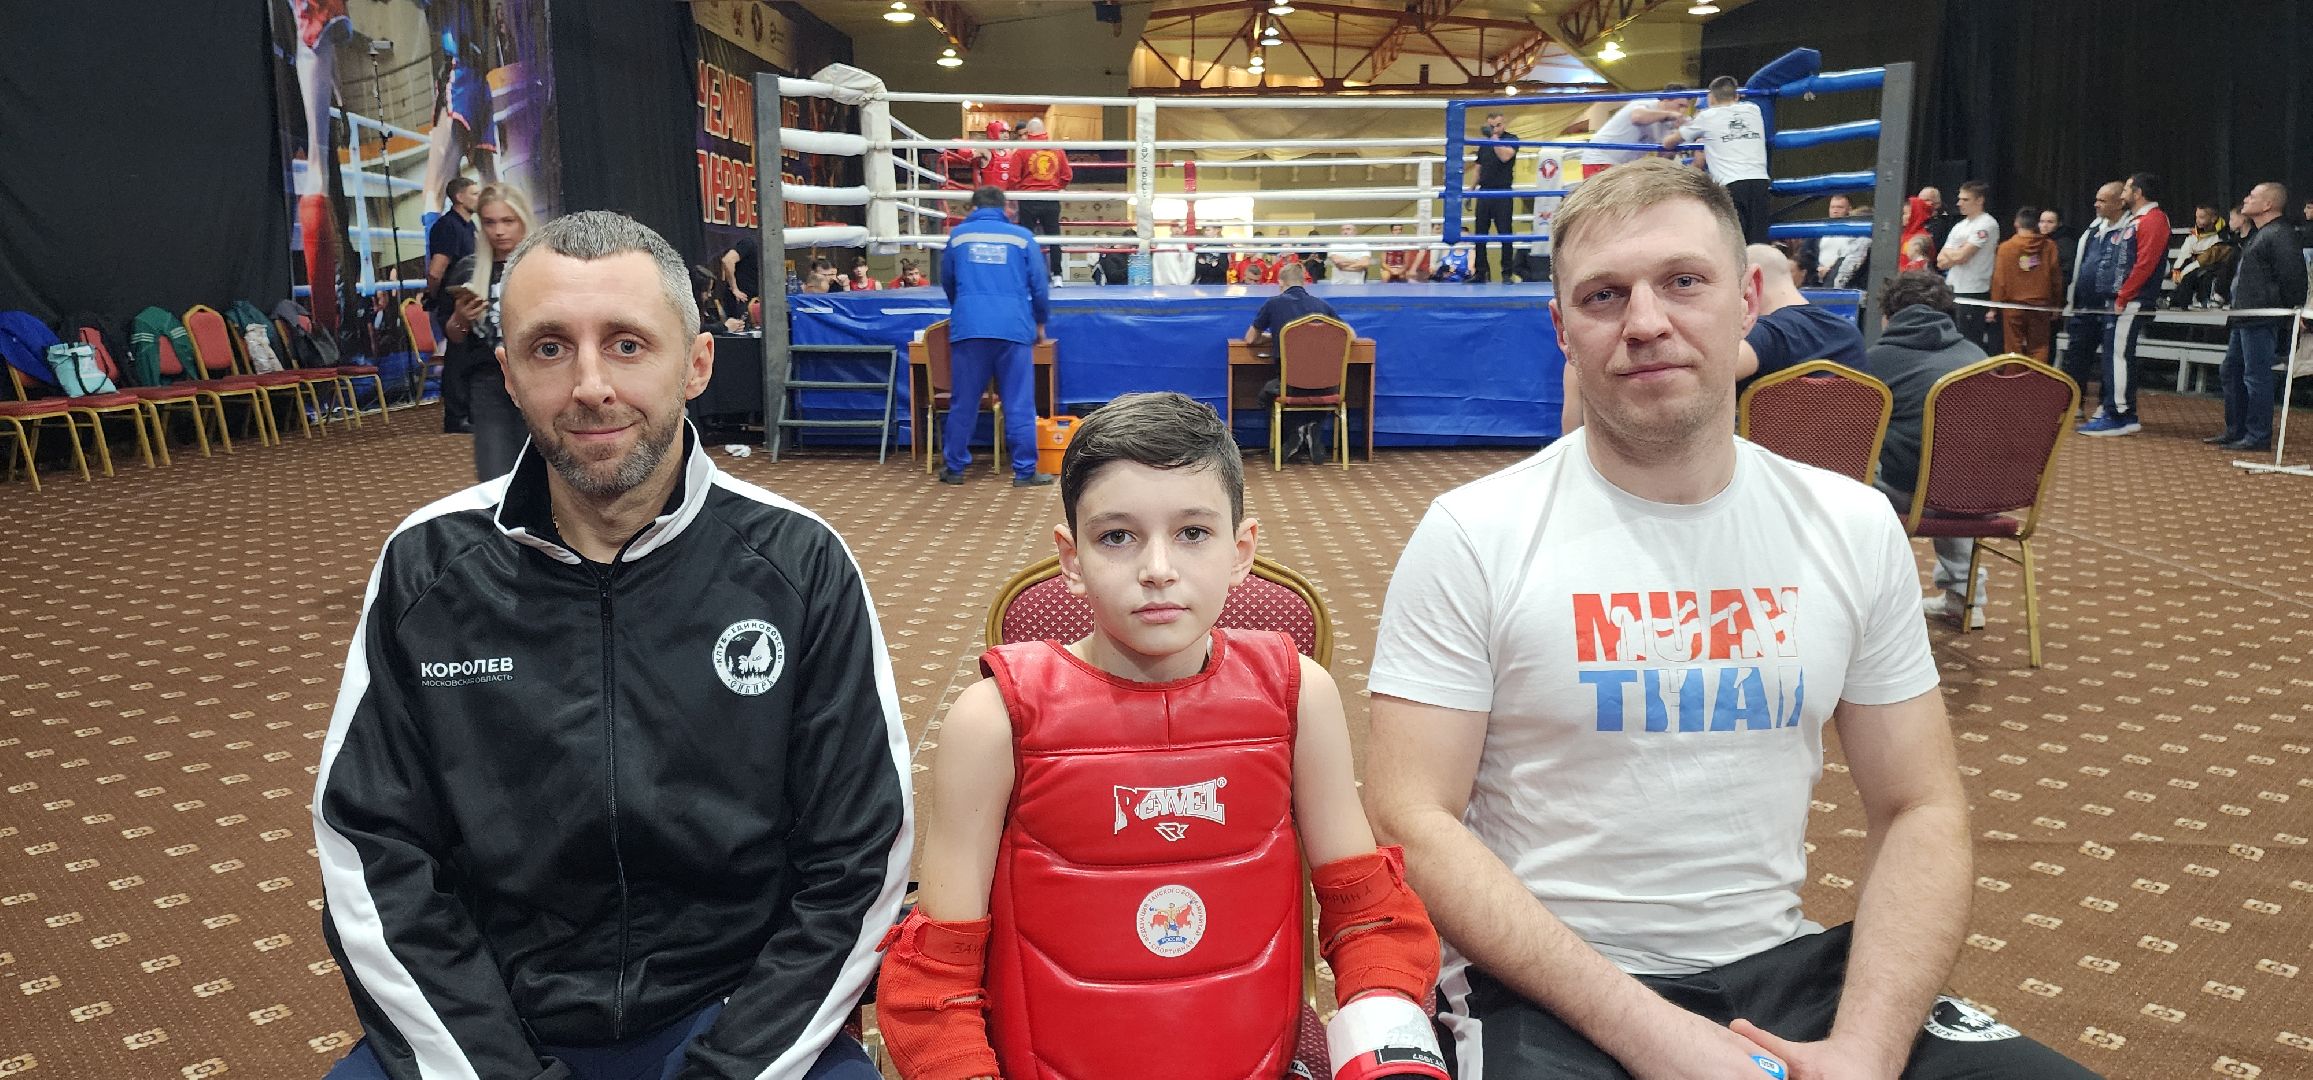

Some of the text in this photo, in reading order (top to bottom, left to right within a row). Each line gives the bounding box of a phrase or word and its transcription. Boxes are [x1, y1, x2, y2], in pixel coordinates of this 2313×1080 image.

[696, 149, 808, 229] ПЕРВЕВО
[1573, 586, 1799, 662] MUAY
[421, 657, 514, 678] КОРОЛЕВ
[716, 637, 727, 664] КЛУБ
[422, 674, 514, 687] МОСКОВСКАЯ ОБЛАСТЬ
[1579, 666, 1804, 732] THAI
